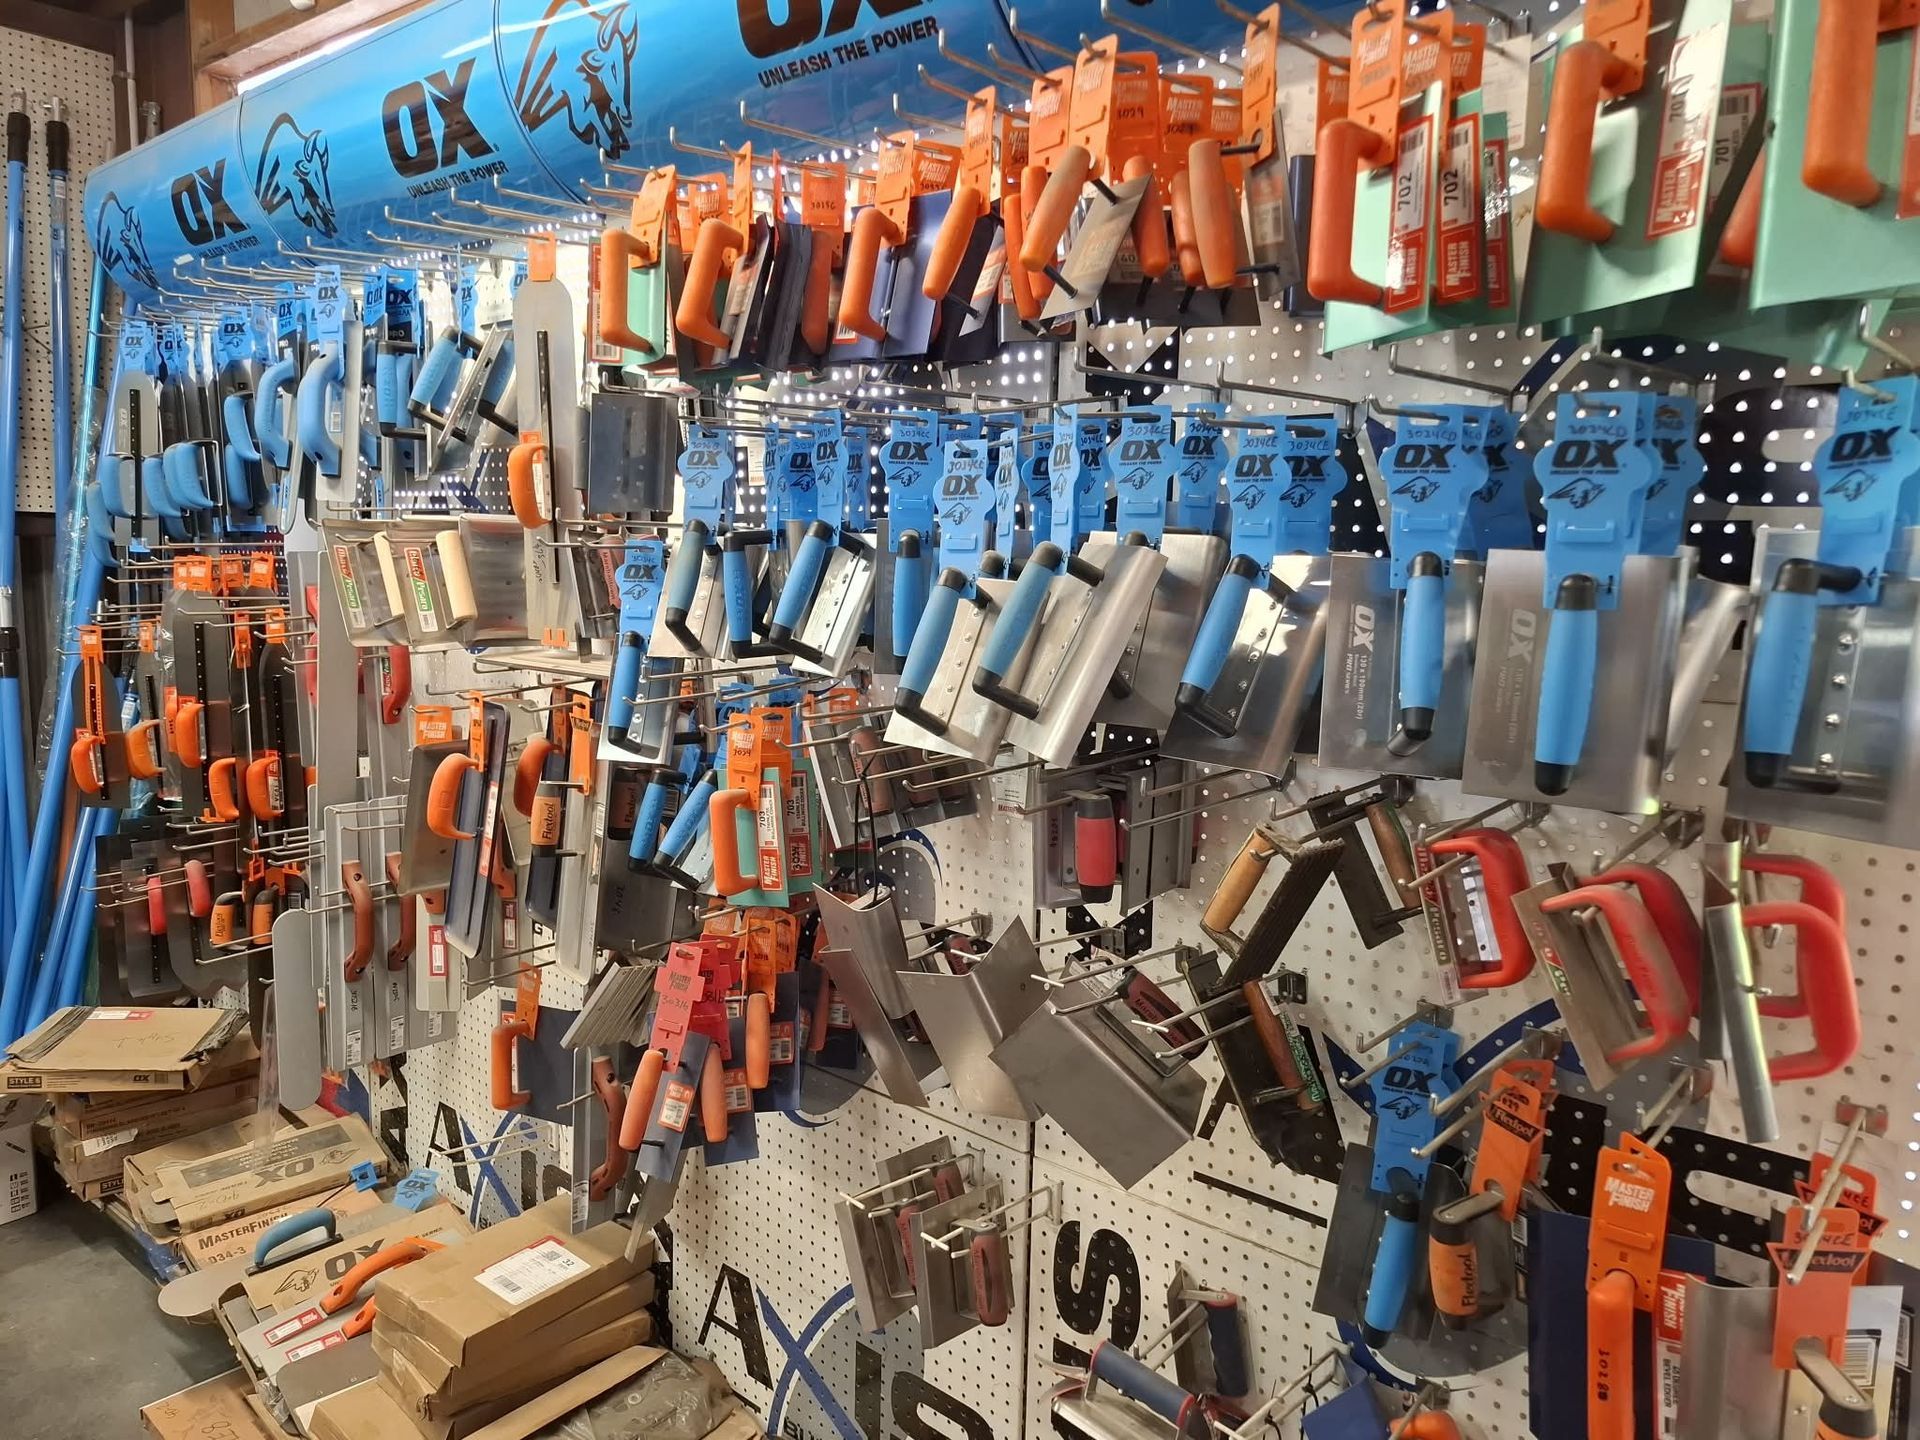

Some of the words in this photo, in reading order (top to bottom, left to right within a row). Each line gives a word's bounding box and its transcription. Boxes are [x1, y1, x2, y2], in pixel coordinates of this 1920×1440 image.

[757, 51, 832, 89] UNLEASH
[831, 39, 870, 65] THE
[870, 15, 939, 53] POWER
[382, 57, 495, 178] OX
[1715, 137, 1730, 166] 701
[406, 177, 450, 199] UNLEASH
[448, 171, 472, 188] THE
[469, 159, 510, 182] POWER
[1398, 171, 1413, 211] 702
[1443, 168, 1459, 207] 702
[171, 157, 248, 246] OX
[1446, 242, 1460, 286] MASTER
[1458, 240, 1471, 278] FINISH
[316, 285, 339, 300] OX
[386, 289, 413, 304] OX
[278, 300, 293, 317] OX
[223, 322, 246, 334] OX
[125, 336, 144, 346] OX
[816, 439, 839, 461] OX
[889, 441, 933, 461] OX
[1053, 441, 1073, 467] OX
[1119, 439, 1167, 461] OX
[1182, 435, 1221, 455] OX
[1393, 443, 1456, 468] OX
[1552, 439, 1629, 468] OX
[1829, 425, 1902, 462] OX
[686, 450, 722, 467] OX
[765, 449, 777, 468] OX
[847, 453, 863, 471] OX
[1234, 453, 1280, 478] OX
[942, 474, 982, 496] OX
[623, 564, 659, 580] OX
[416, 581, 429, 610] Pesaro
[1352, 604, 1376, 653] OX
[1507, 608, 1537, 663] OX
[419, 720, 447, 732] MASTER
[786, 799, 796, 817] 703
[542, 801, 554, 840] Flextool
[762, 855, 772, 885] MASTER
[770, 856, 779, 882] FINISH
[668, 970, 692, 985] MASTER
[670, 980, 690, 992] FINISH
[8, 1077, 34, 1086] STYLE
[132, 1074, 151, 1083] OX
[1383, 1065, 1438, 1094] OX
[253, 1156, 315, 1189] OX
[402, 1180, 427, 1191] OX
[1604, 1176, 1655, 1200] MASTER
[1608, 1189, 1651, 1213] FINISH
[224, 1207, 246, 1221] OX
[562, 1258, 575, 1267] 32
[1460, 1253, 1474, 1308] Flextool
[1660, 1285, 1678, 1330] FINISH
